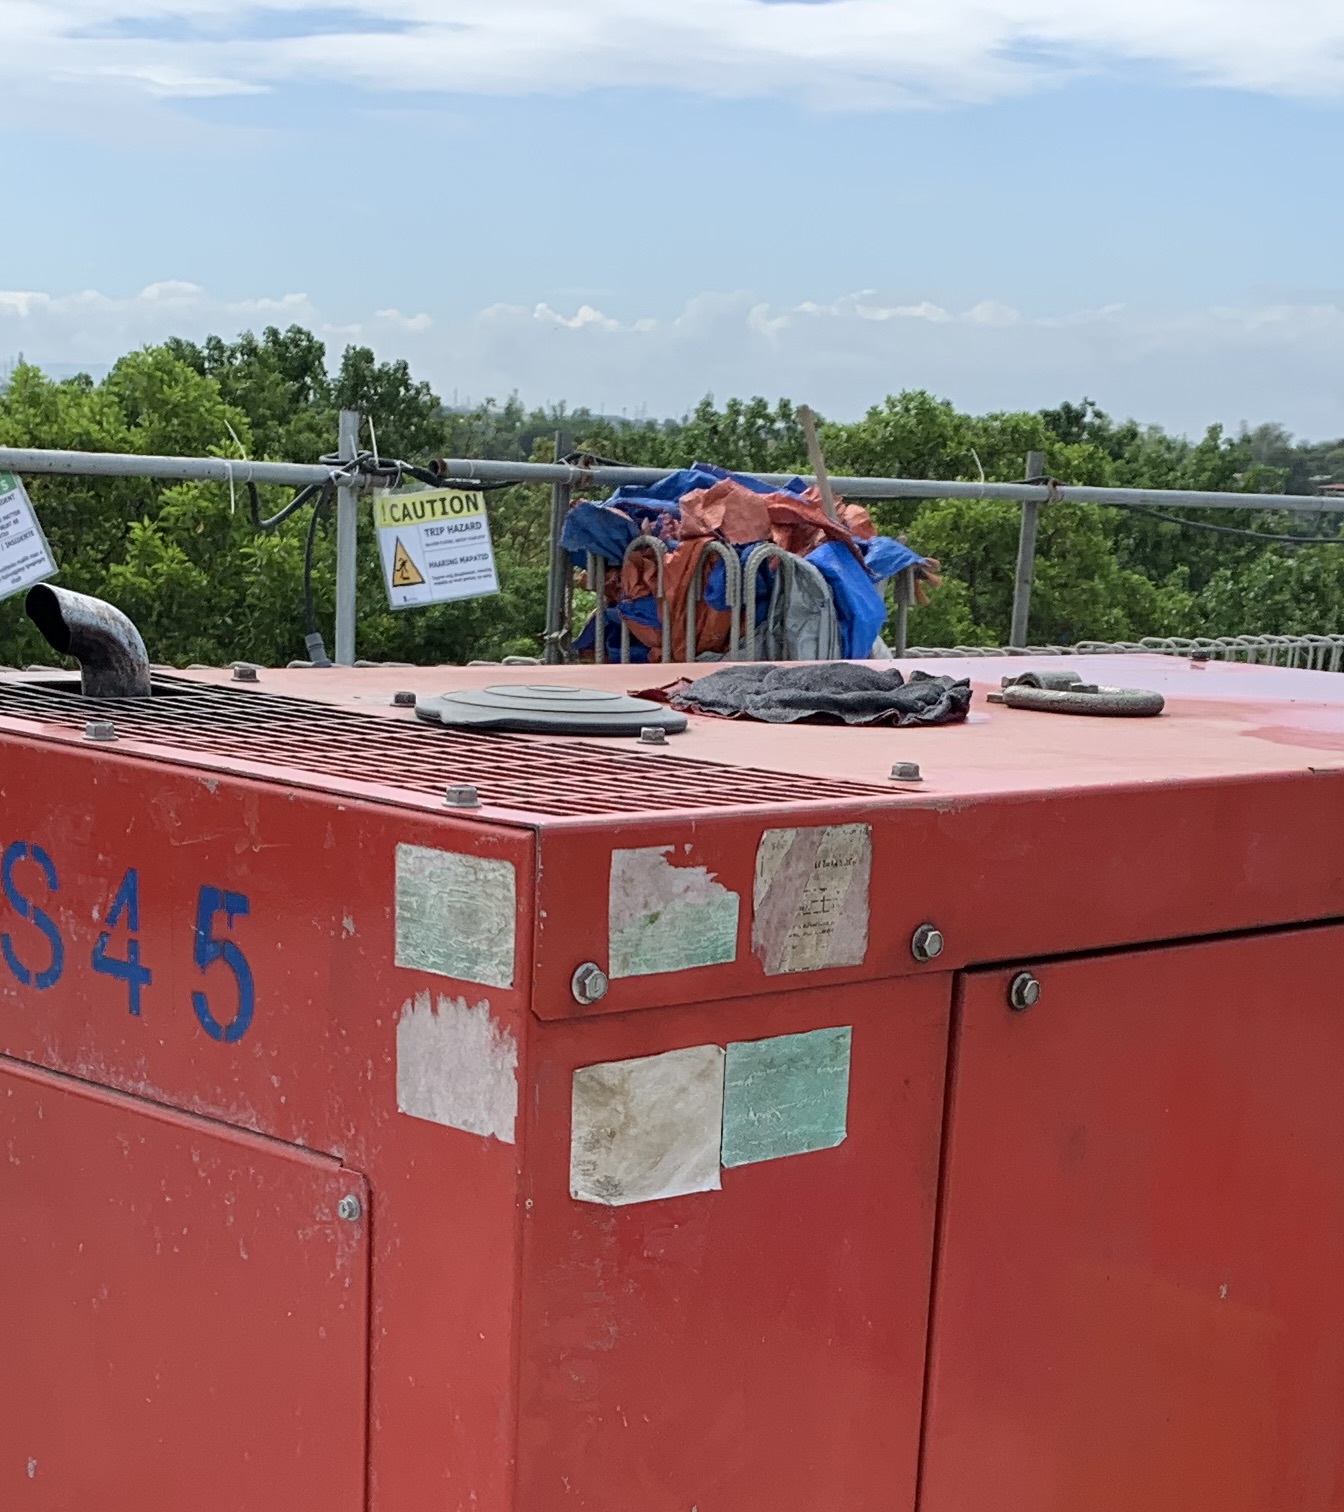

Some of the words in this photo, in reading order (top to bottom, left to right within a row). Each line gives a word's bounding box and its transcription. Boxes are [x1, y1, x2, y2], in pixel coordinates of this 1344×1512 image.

[390, 493, 479, 522] CAUTION
[424, 526, 444, 537] TRIP
[447, 521, 482, 534] HAZARD
